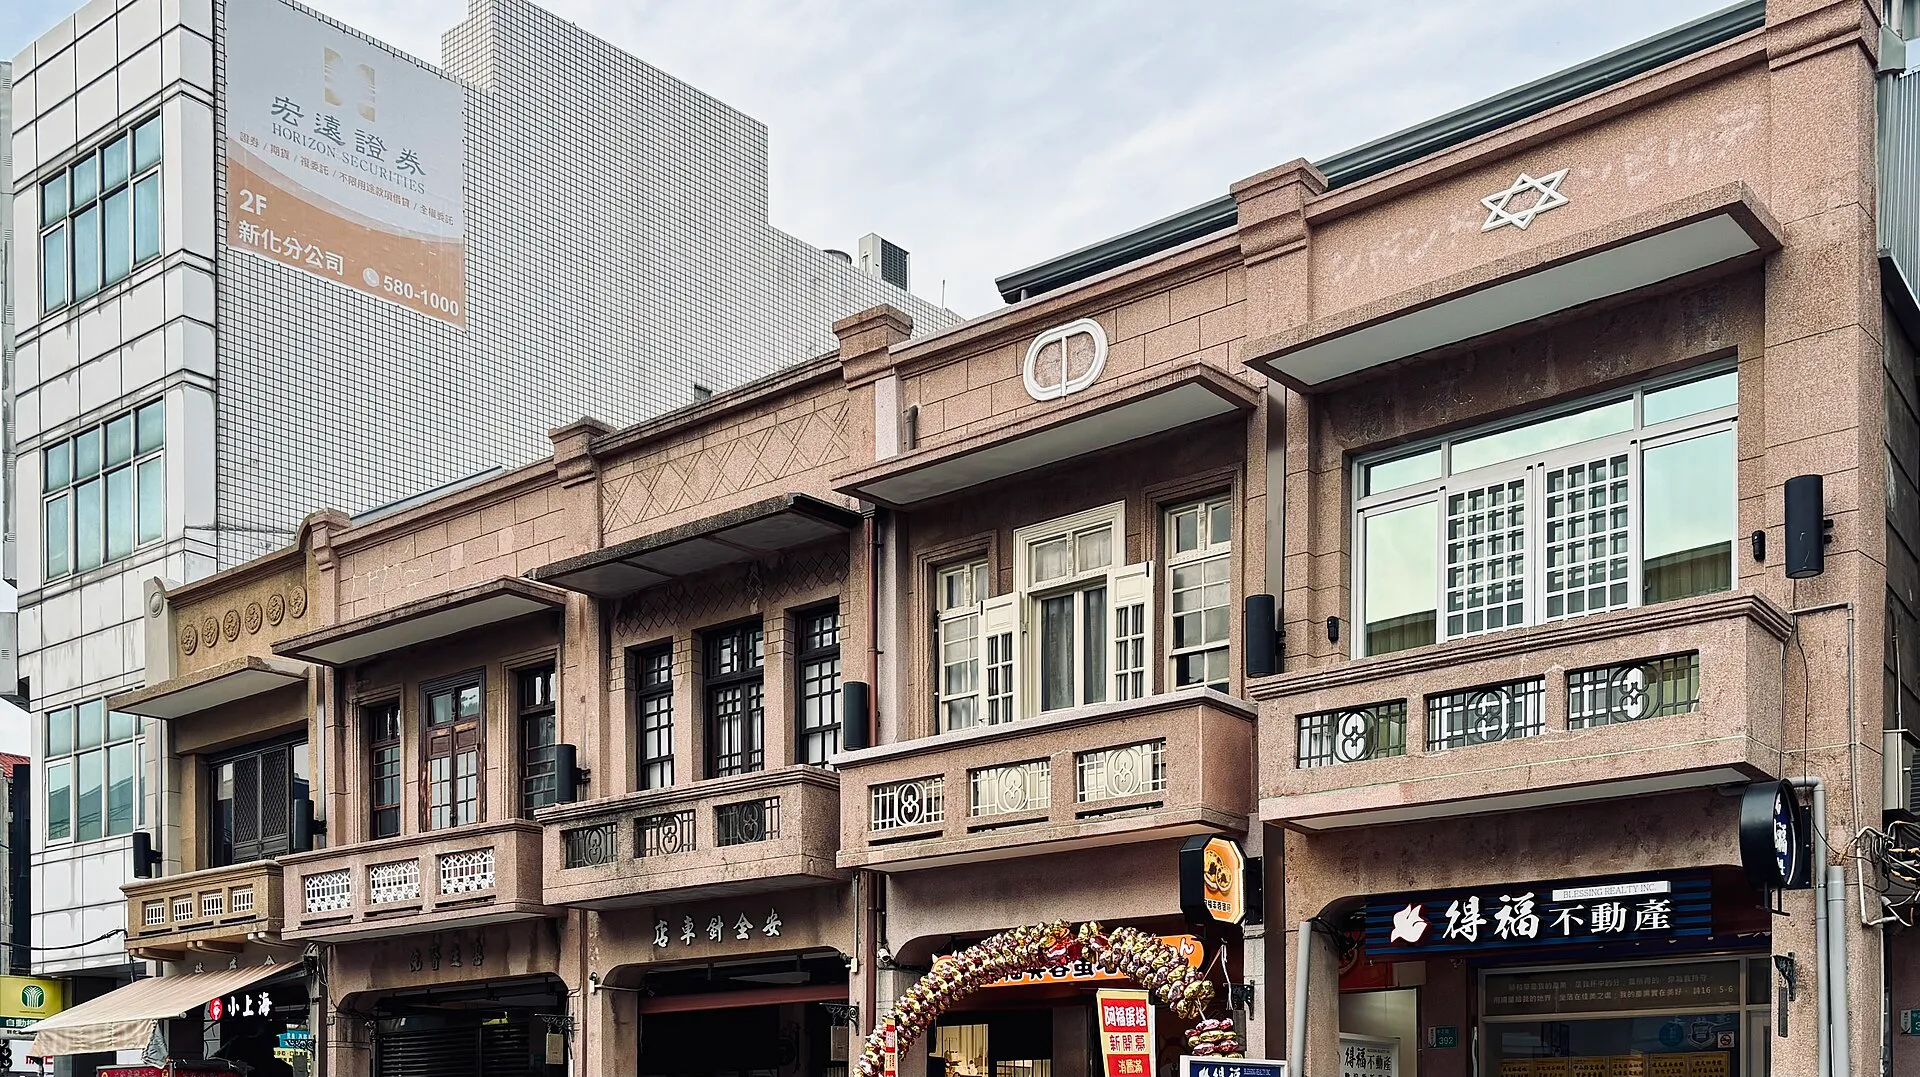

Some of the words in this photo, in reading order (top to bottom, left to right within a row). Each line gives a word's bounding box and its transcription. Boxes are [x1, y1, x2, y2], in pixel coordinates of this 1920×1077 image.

[271, 96, 426, 176] 宏遠證券
[272, 122, 336, 159] HORIZON
[342, 151, 425, 195] SECURITIES
[239, 188, 267, 217] 2F
[238, 219, 345, 276] 新化分公司
[383, 274, 459, 317] 580-1000
[1563, 888, 1603, 899] BLESSING
[1604, 885, 1638, 895] REALTY
[1441, 891, 1671, 942] 得福不動產
[227, 991, 272, 1017] 小上海
[1104, 1005, 1146, 1027] 阿福蛋塔
[1109, 1034, 1145, 1051] 新開幕
[1438, 1036, 1454, 1045] 392
[1344, 1046, 1392, 1071] 得福不動產
